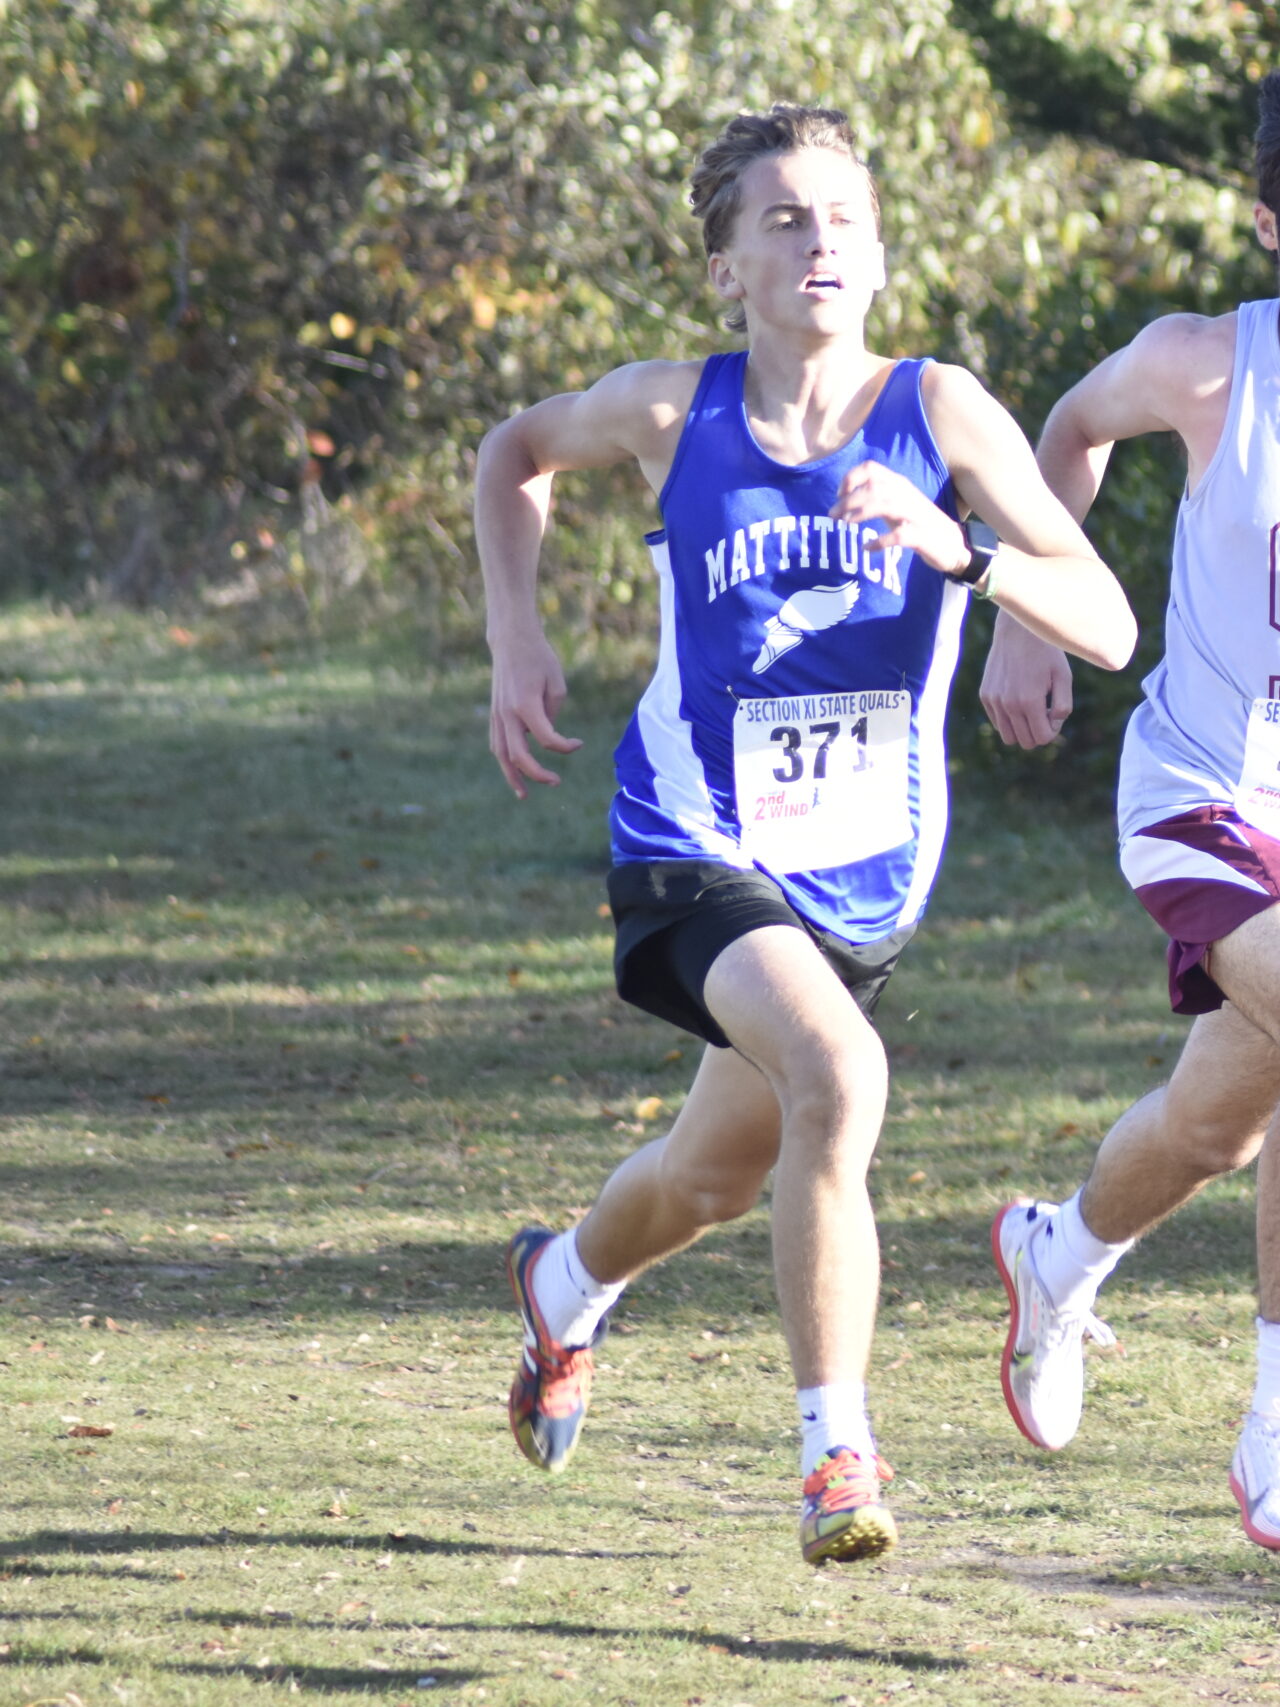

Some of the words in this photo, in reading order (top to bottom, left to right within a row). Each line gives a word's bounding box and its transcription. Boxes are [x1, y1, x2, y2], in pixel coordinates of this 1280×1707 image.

[704, 515, 903, 604] MATTITUCK
[747, 699, 800, 722] SECTION
[804, 698, 816, 720] XI
[819, 693, 856, 718] STATE
[859, 693, 900, 714] QUALS
[770, 716, 869, 783] 371
[769, 803, 809, 818] WIND
